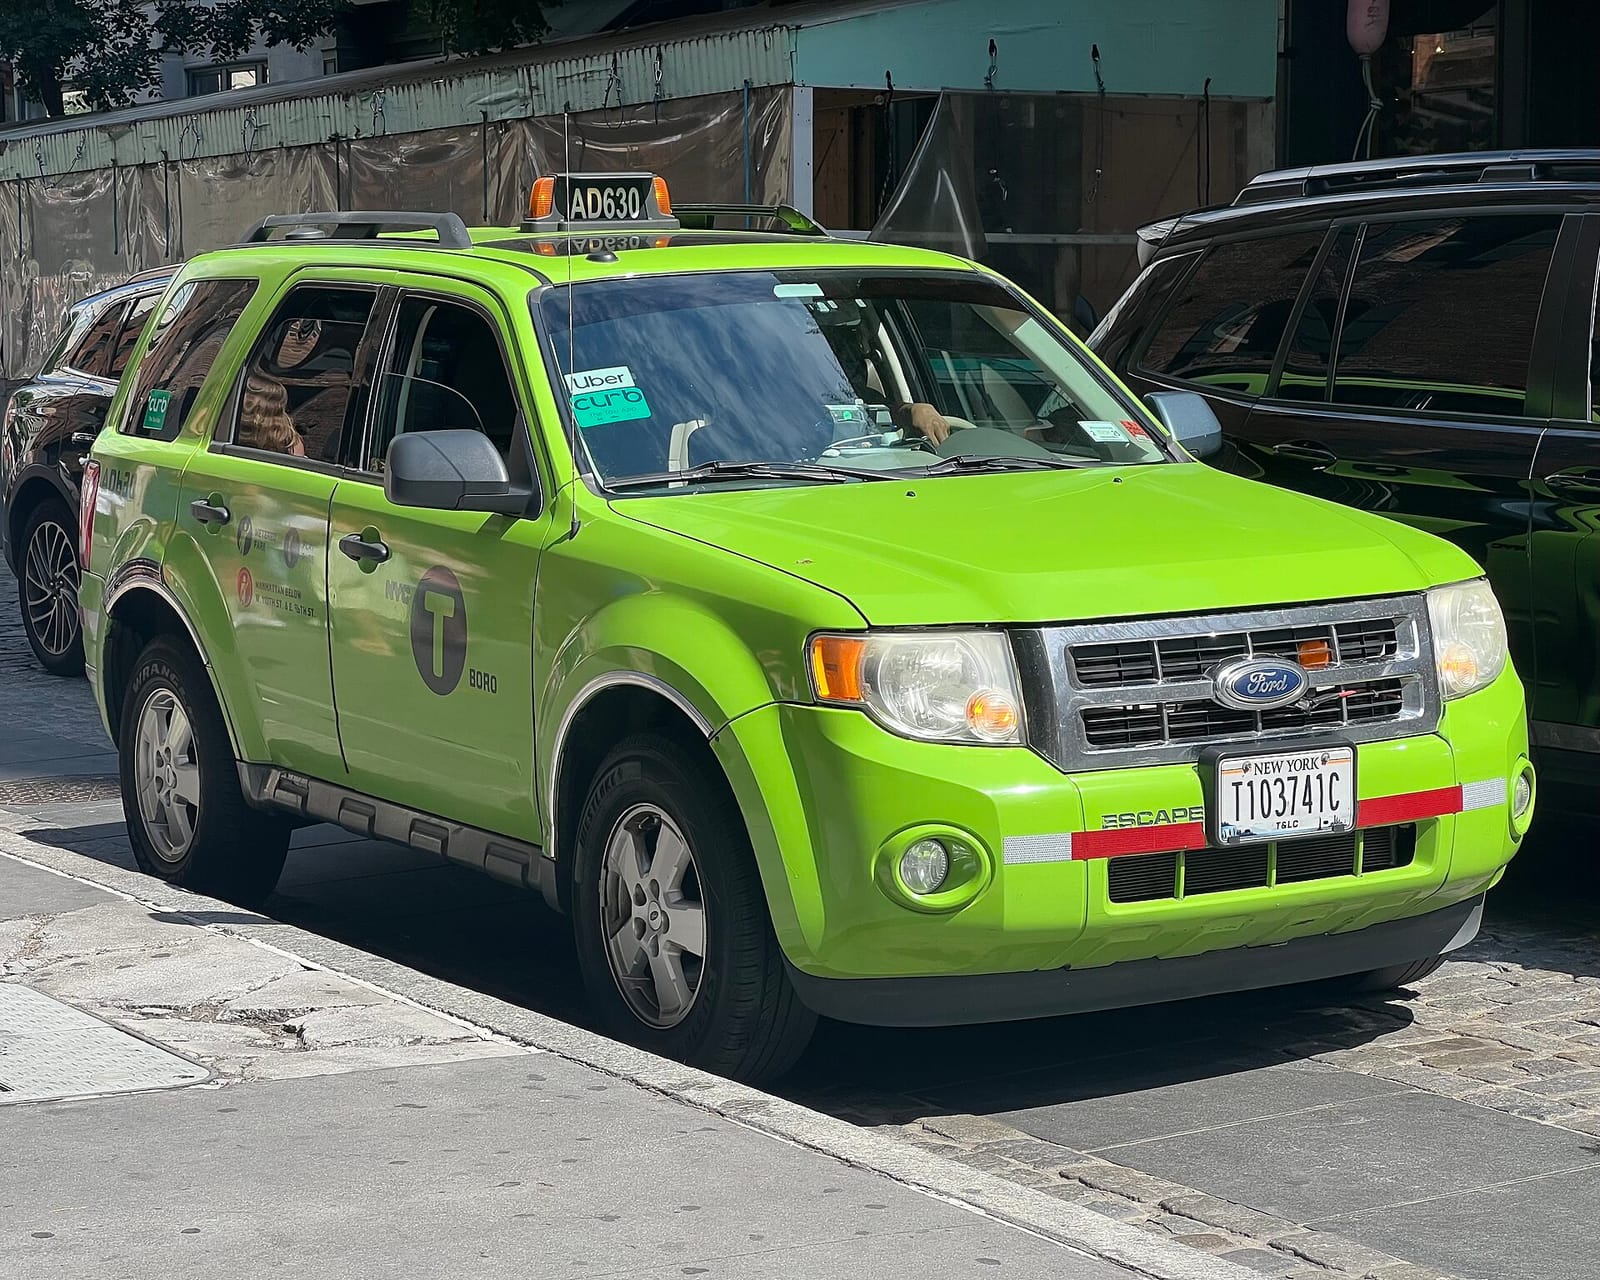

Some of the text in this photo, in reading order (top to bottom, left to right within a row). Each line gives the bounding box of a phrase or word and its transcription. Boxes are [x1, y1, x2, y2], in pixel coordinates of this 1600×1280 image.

[571, 187, 640, 220] AD630
[573, 374, 624, 389] Uber
[149, 397, 167, 413] curb
[574, 390, 642, 410] curb
[469, 668, 498, 693] BORO
[1246, 671, 1289, 695] Ford
[1254, 756, 1320, 775] NEW YORK
[1232, 772, 1340, 822] T103741C
[1101, 805, 1204, 830] ESCAPE
[1276, 820, 1299, 830] T&LC
